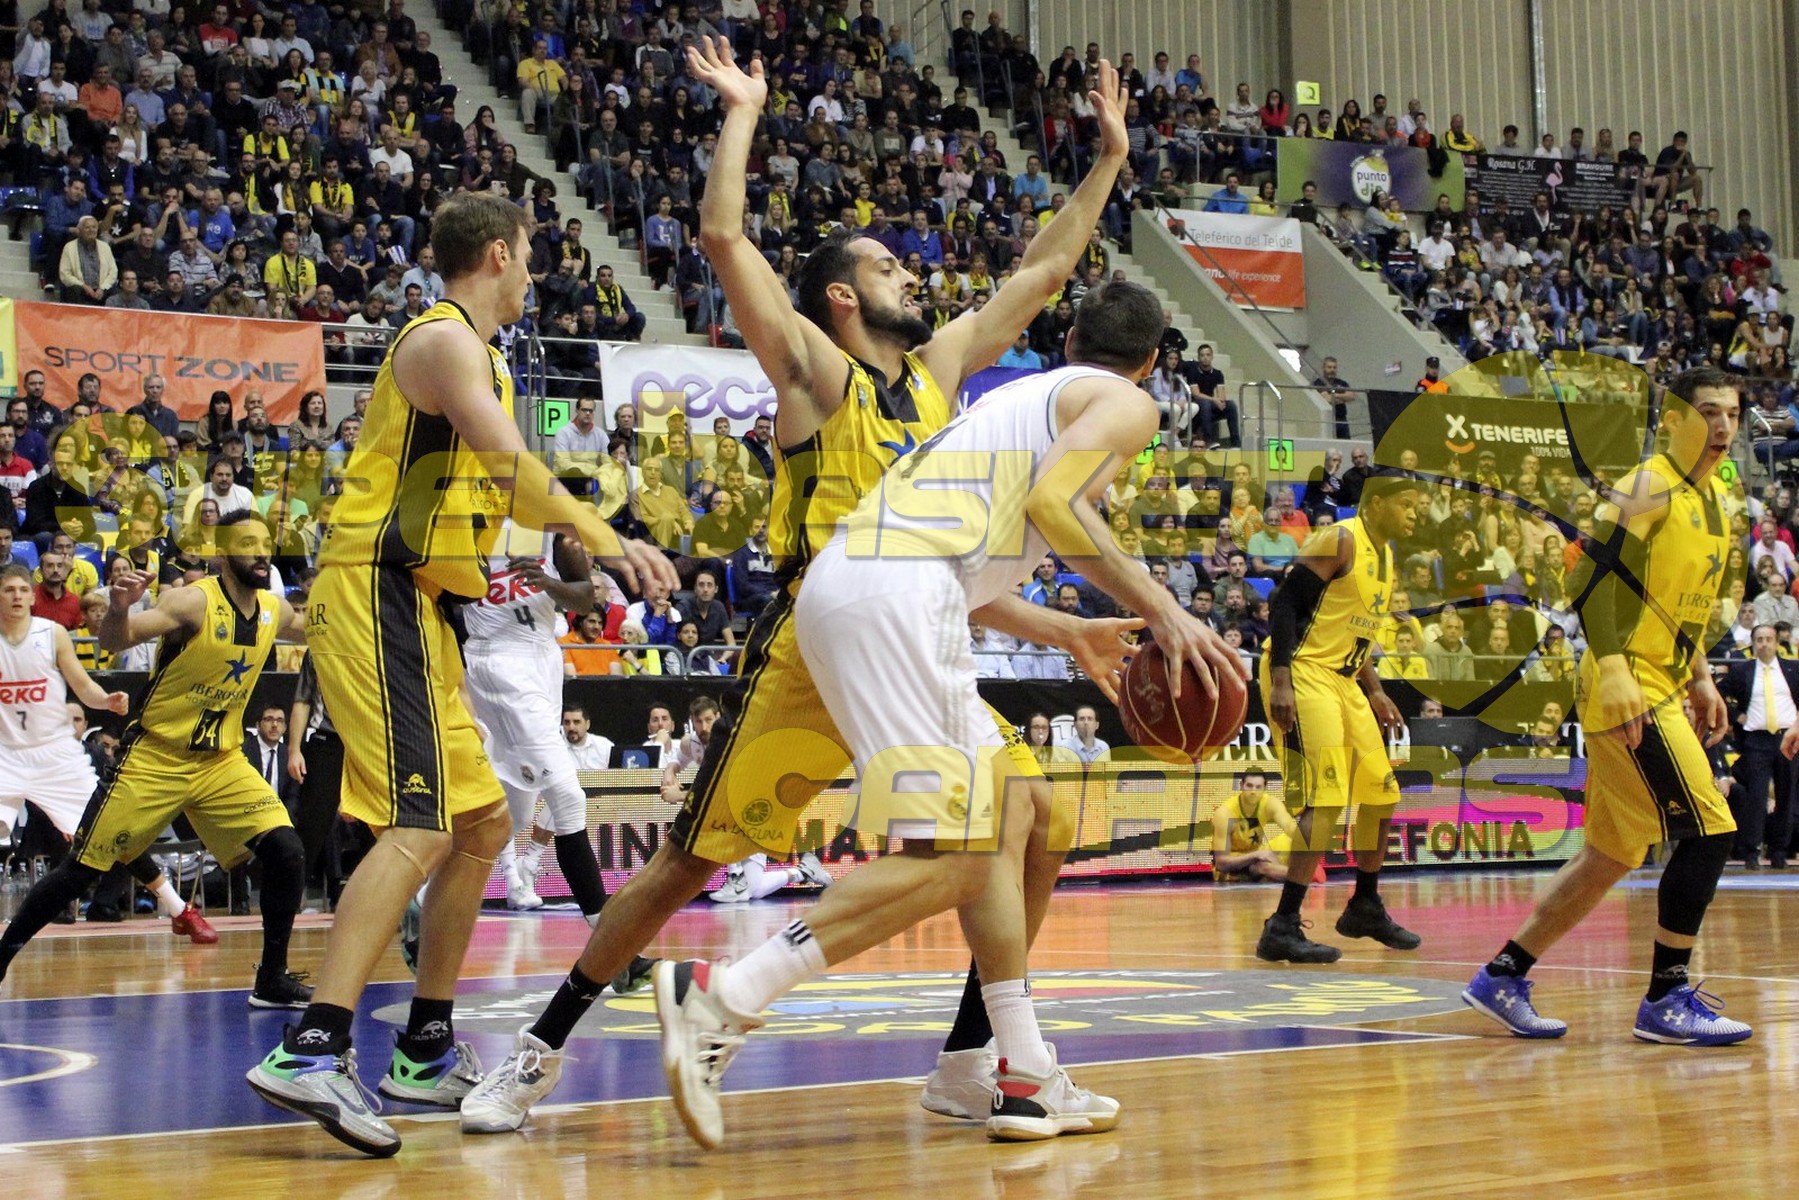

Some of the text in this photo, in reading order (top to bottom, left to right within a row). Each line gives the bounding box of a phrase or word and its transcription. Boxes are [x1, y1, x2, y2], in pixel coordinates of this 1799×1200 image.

[1357, 171, 1387, 183] punto
[1244, 234, 1261, 246] del
[1263, 233, 1293, 248] Teide
[44, 346, 300, 383] SPORT ZONE
[548, 407, 561, 428] P
[1471, 422, 1570, 446] TENERIFE
[1720, 466, 1733, 483] Q
[513, 605, 537, 632] 4
[16, 711, 27, 731] 7
